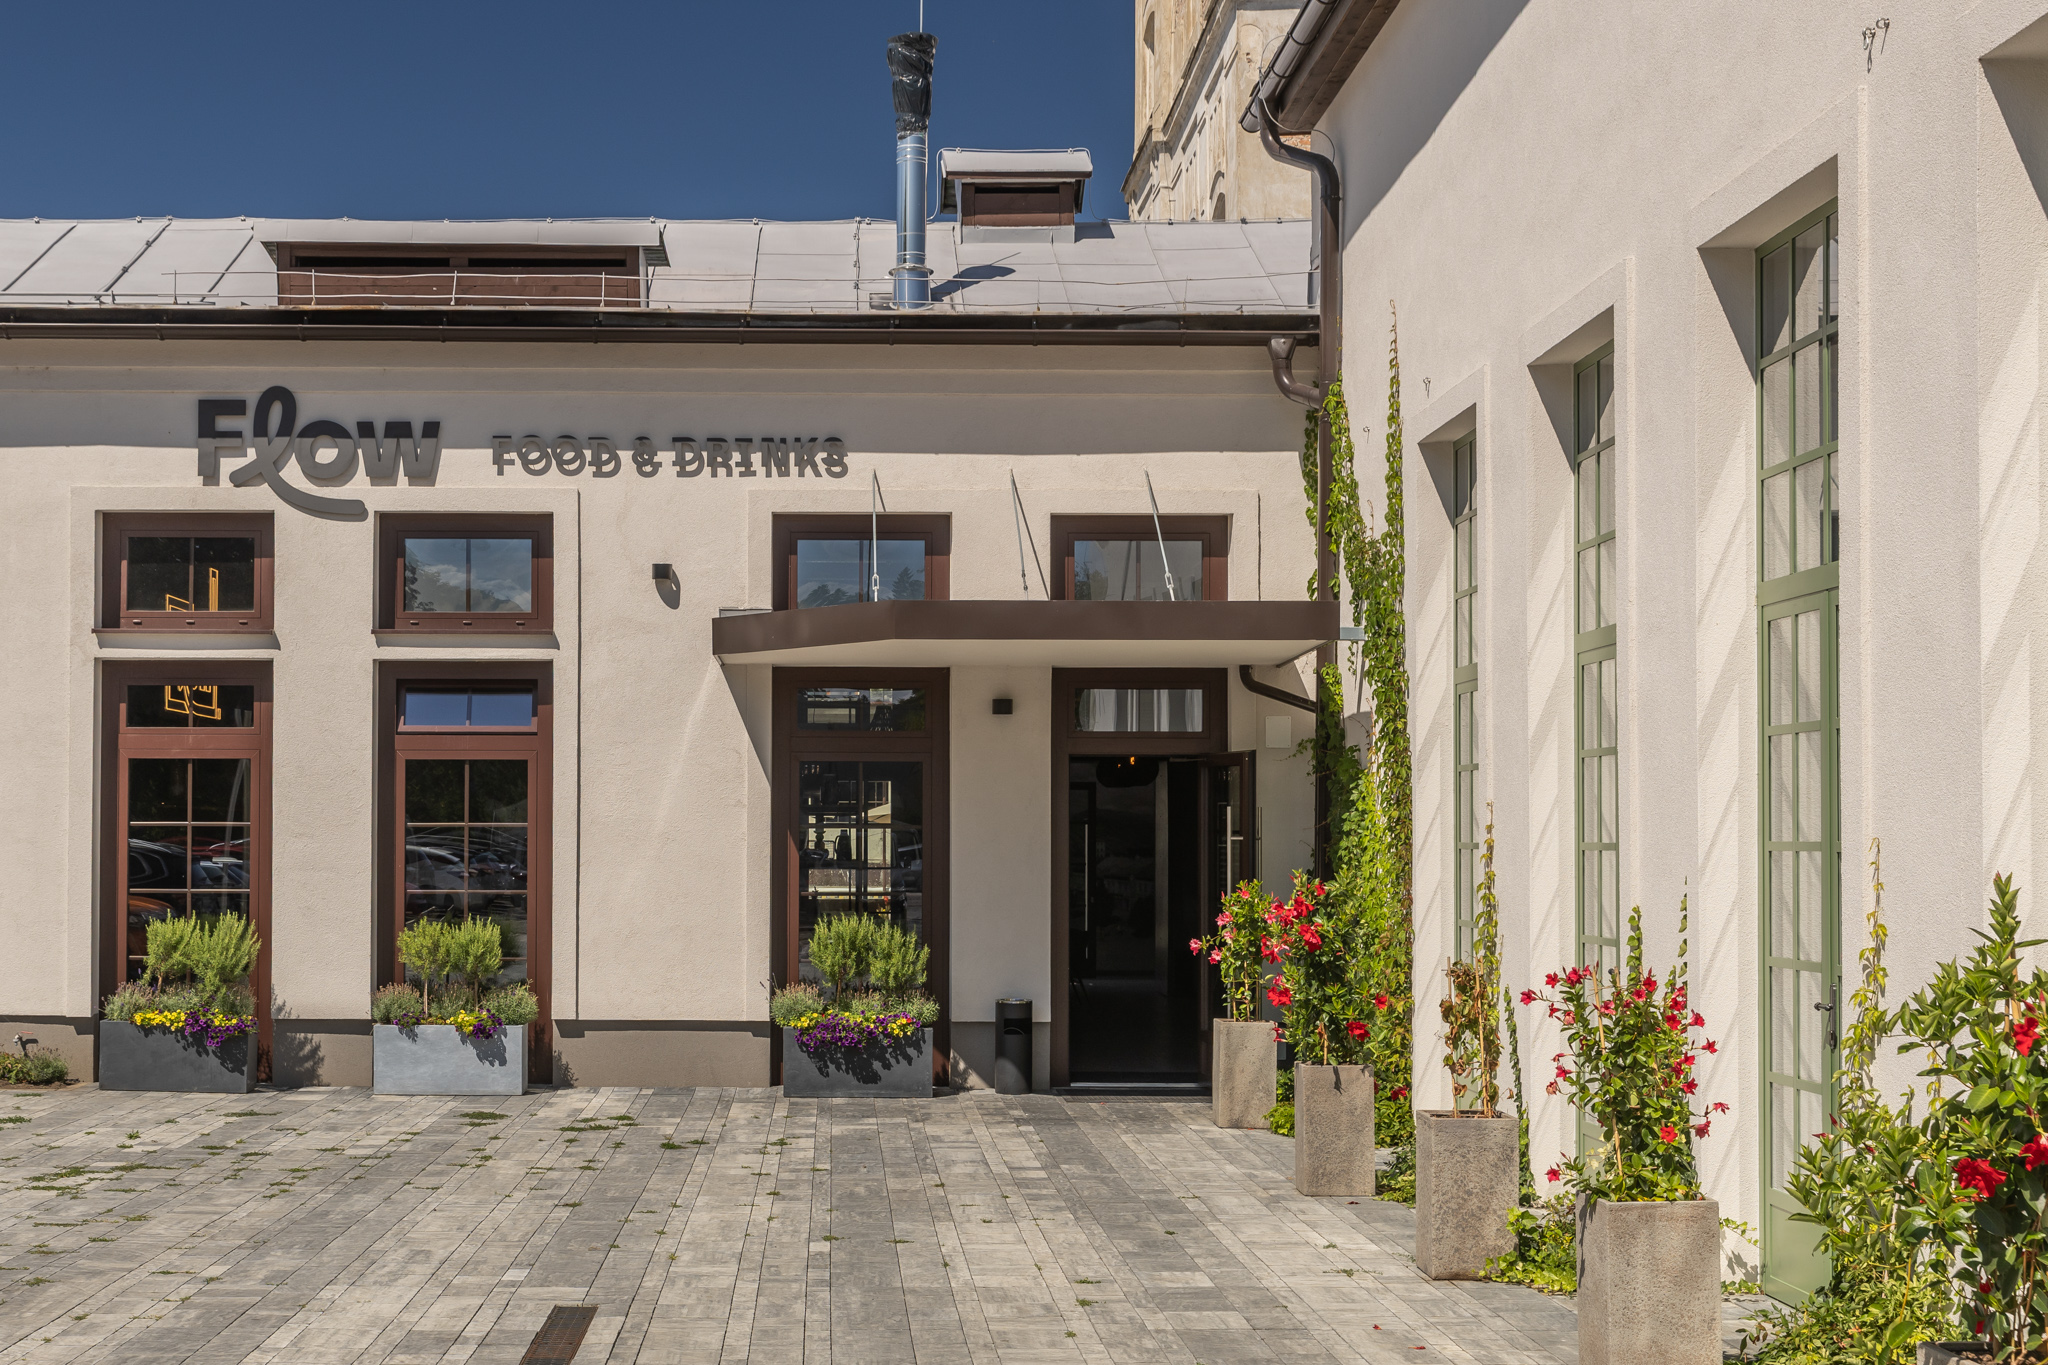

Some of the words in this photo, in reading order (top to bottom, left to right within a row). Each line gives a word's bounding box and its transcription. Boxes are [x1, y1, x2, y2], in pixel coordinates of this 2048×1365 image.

[492, 434, 617, 467] FOOD
[632, 436, 658, 467] &
[672, 437, 845, 468] DRINKS
